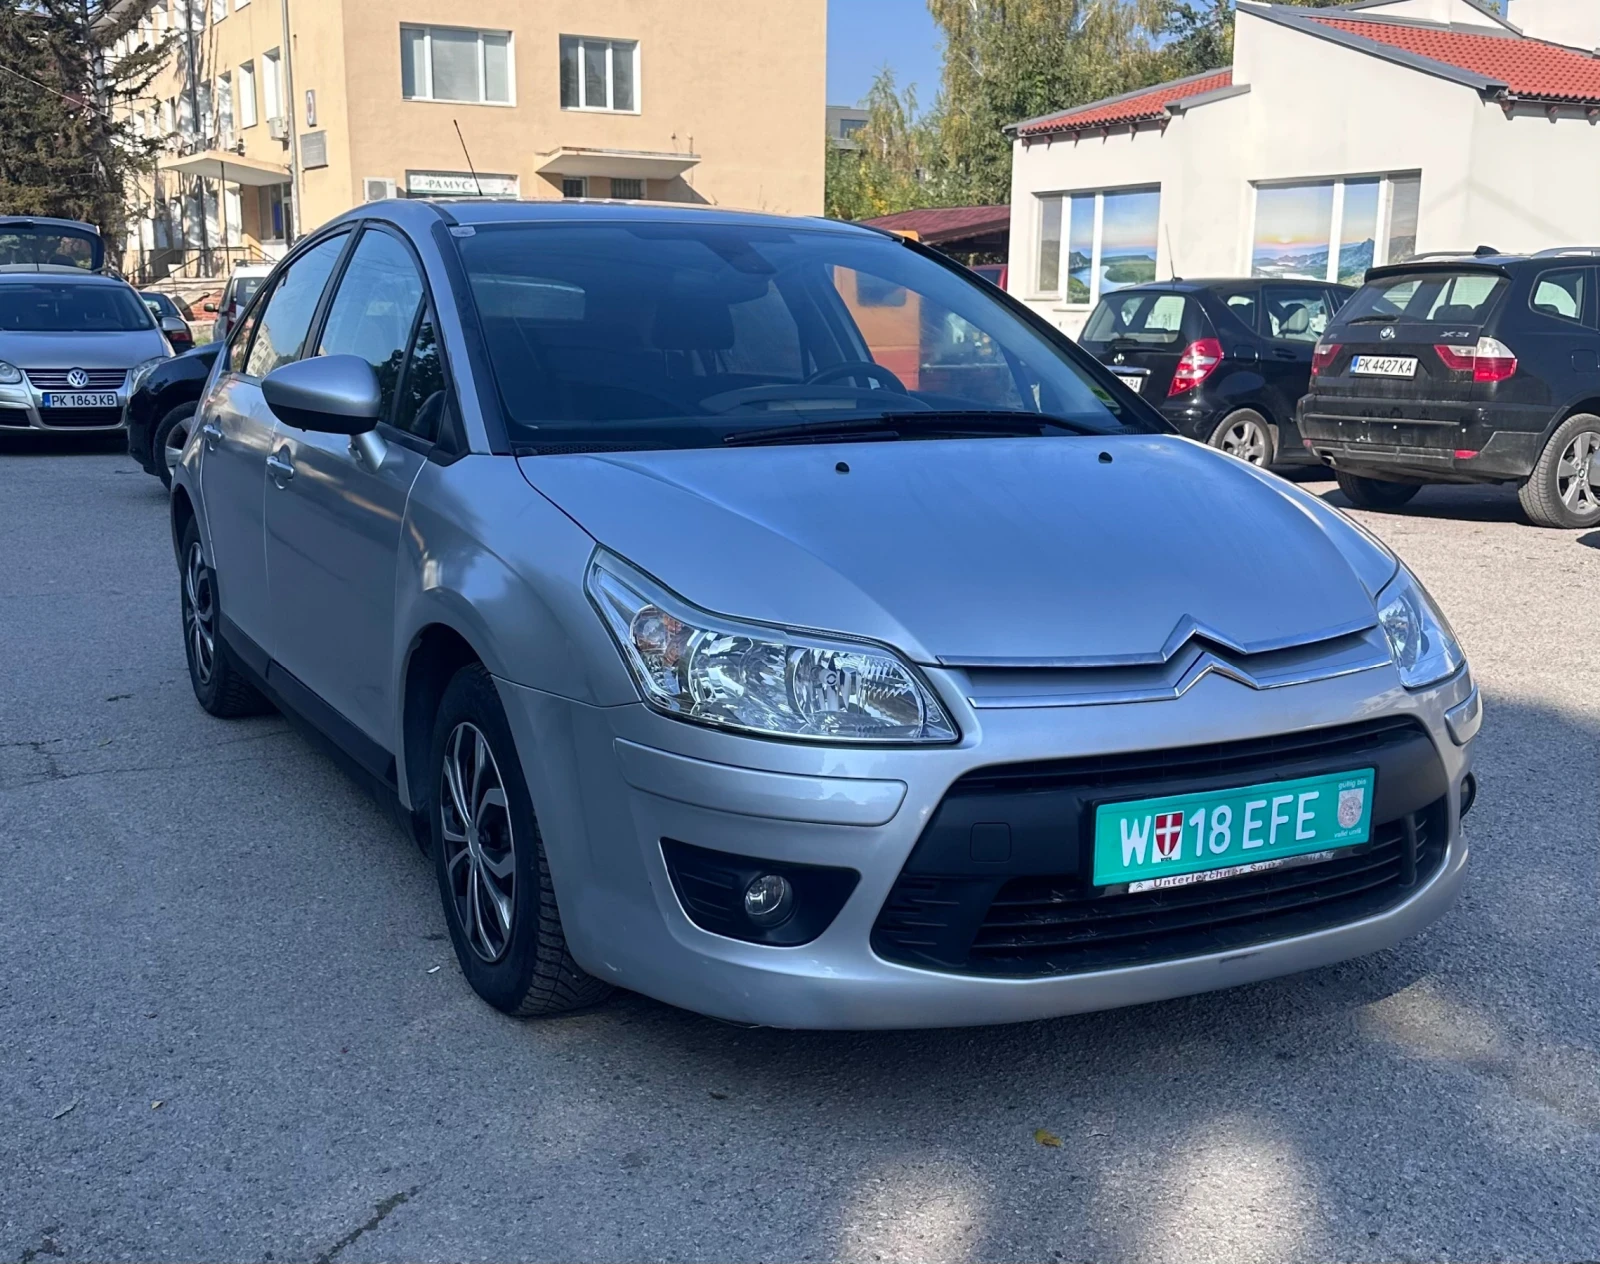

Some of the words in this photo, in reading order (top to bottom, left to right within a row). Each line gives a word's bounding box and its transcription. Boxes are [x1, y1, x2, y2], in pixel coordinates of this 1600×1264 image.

[1372, 358, 1398, 373] 4427
[51, 395, 67, 406] PK
[70, 394, 98, 406] 1863
[1120, 815, 1151, 867] W
[1189, 804, 1232, 857] 18
[1242, 791, 1319, 850] EFE
